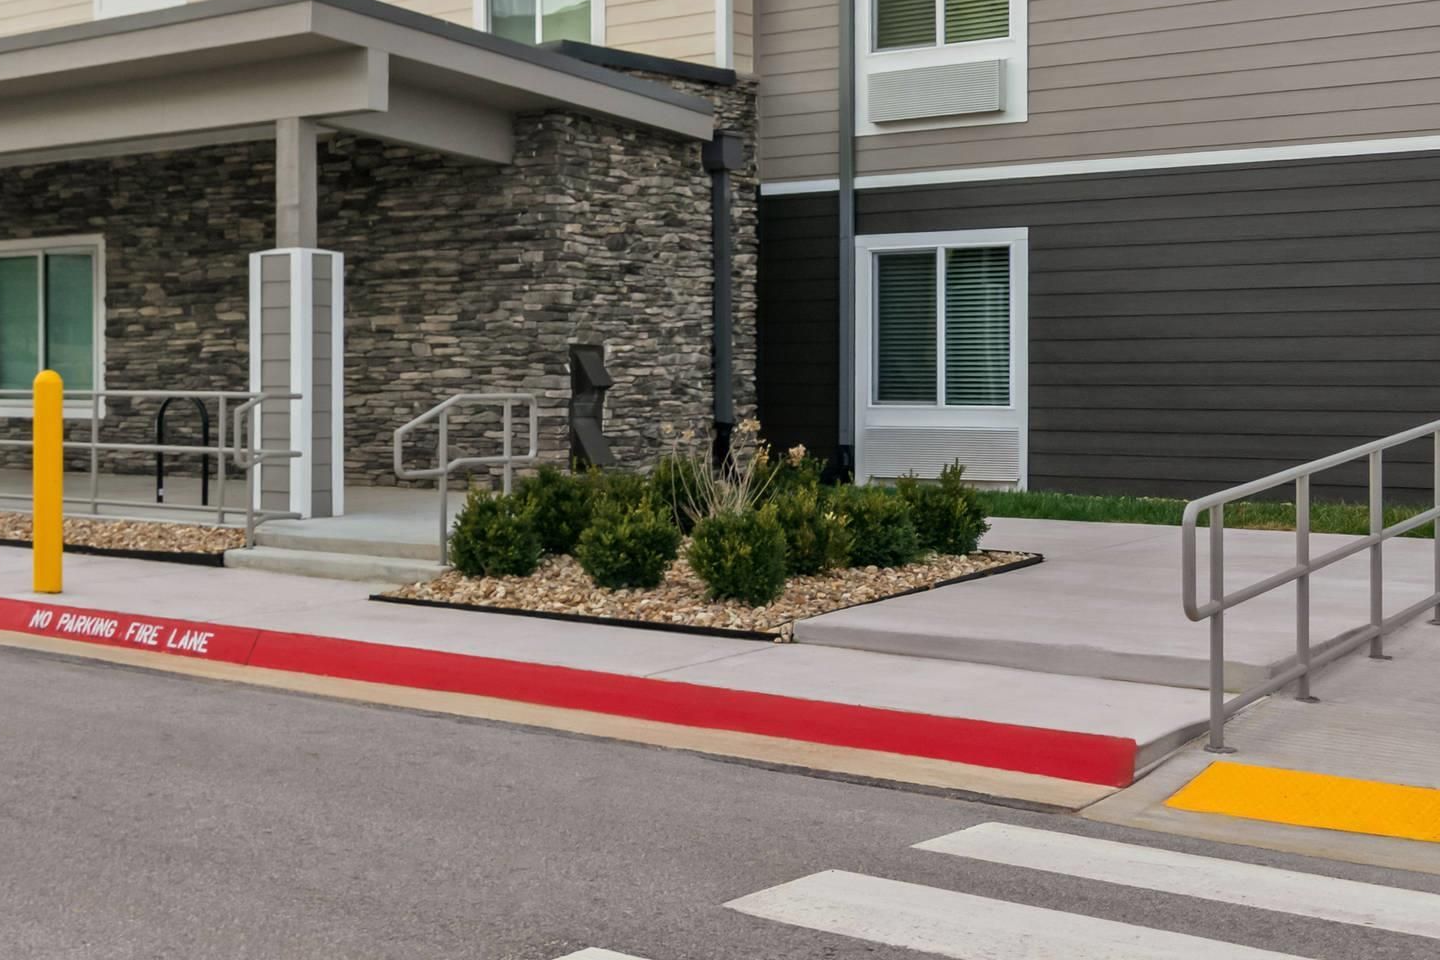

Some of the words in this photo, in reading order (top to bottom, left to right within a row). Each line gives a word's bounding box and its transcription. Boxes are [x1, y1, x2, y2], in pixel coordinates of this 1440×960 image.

[29, 610, 53, 628] NO
[56, 613, 118, 638] PARKING
[124, 622, 163, 646] FIRE
[167, 628, 215, 653] LANE
